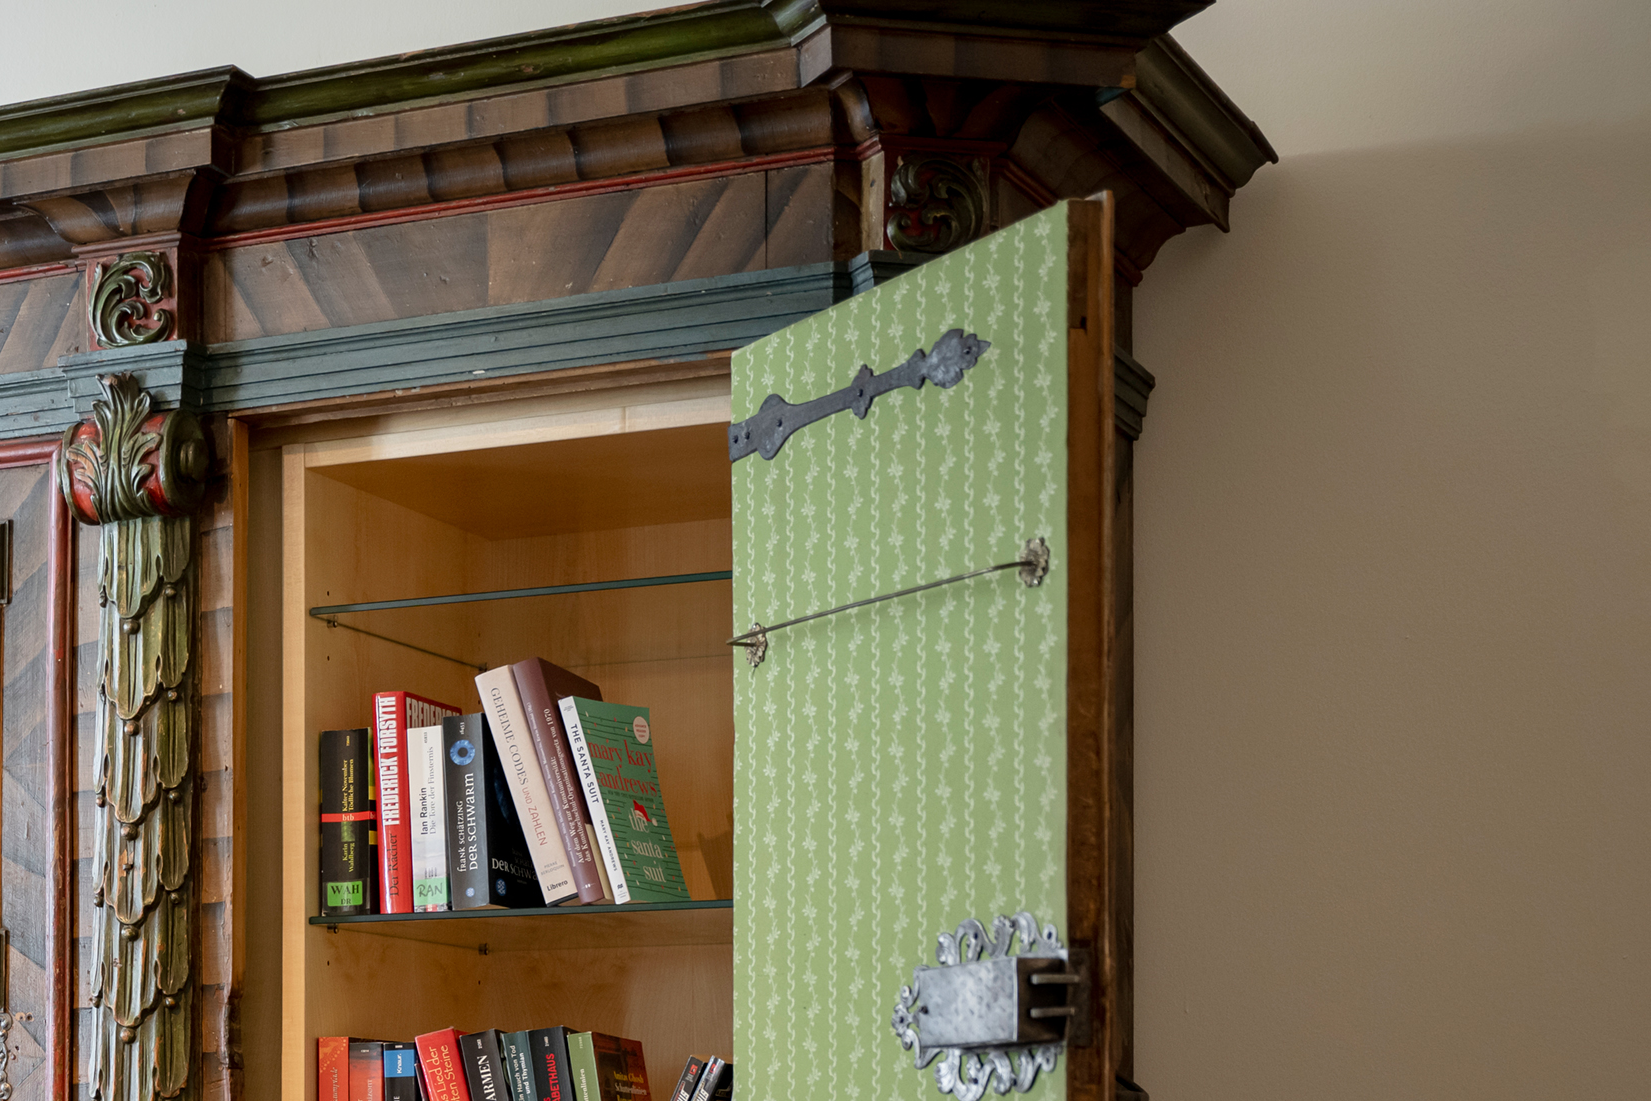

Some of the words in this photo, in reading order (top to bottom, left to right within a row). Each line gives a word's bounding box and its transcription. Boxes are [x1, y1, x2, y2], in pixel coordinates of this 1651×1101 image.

[379, 695, 397, 754] FORSYTH
[543, 708, 553, 725] 1970
[490, 687, 515, 743] GEHEIME
[508, 744, 529, 785] CODES
[522, 787, 532, 805] UND
[528, 805, 548, 846] ZAHLEN
[570, 723, 582, 744] THE
[576, 746, 591, 780] SANTA
[586, 781, 600, 804] SUIT
[587, 741, 623, 768] mary
[623, 739, 653, 773] kay
[380, 756, 400, 825] FREDERICK
[599, 766, 658, 797] andrews
[419, 787, 428, 818] Rankin
[567, 820, 577, 836] Weg
[387, 834, 398, 871] Rächer
[572, 836, 580, 851] dem
[630, 840, 664, 859] santa
[575, 851, 584, 863] Auf
[583, 850, 591, 862] das
[607, 846, 617, 872] ANDREWS
[642, 860, 667, 883] suit
[330, 884, 359, 894] WAH
[389, 877, 399, 896] Der
[416, 882, 443, 898] RAN
[546, 880, 568, 892] Librero
[426, 1046, 440, 1066] der
[440, 1044, 456, 1080] Steine
[509, 1045, 517, 1058] Tod
[519, 1052, 528, 1080] Thymian
[429, 1067, 446, 1093] Lied
[514, 1072, 523, 1093] Hauch
[523, 1081, 531, 1095] und
